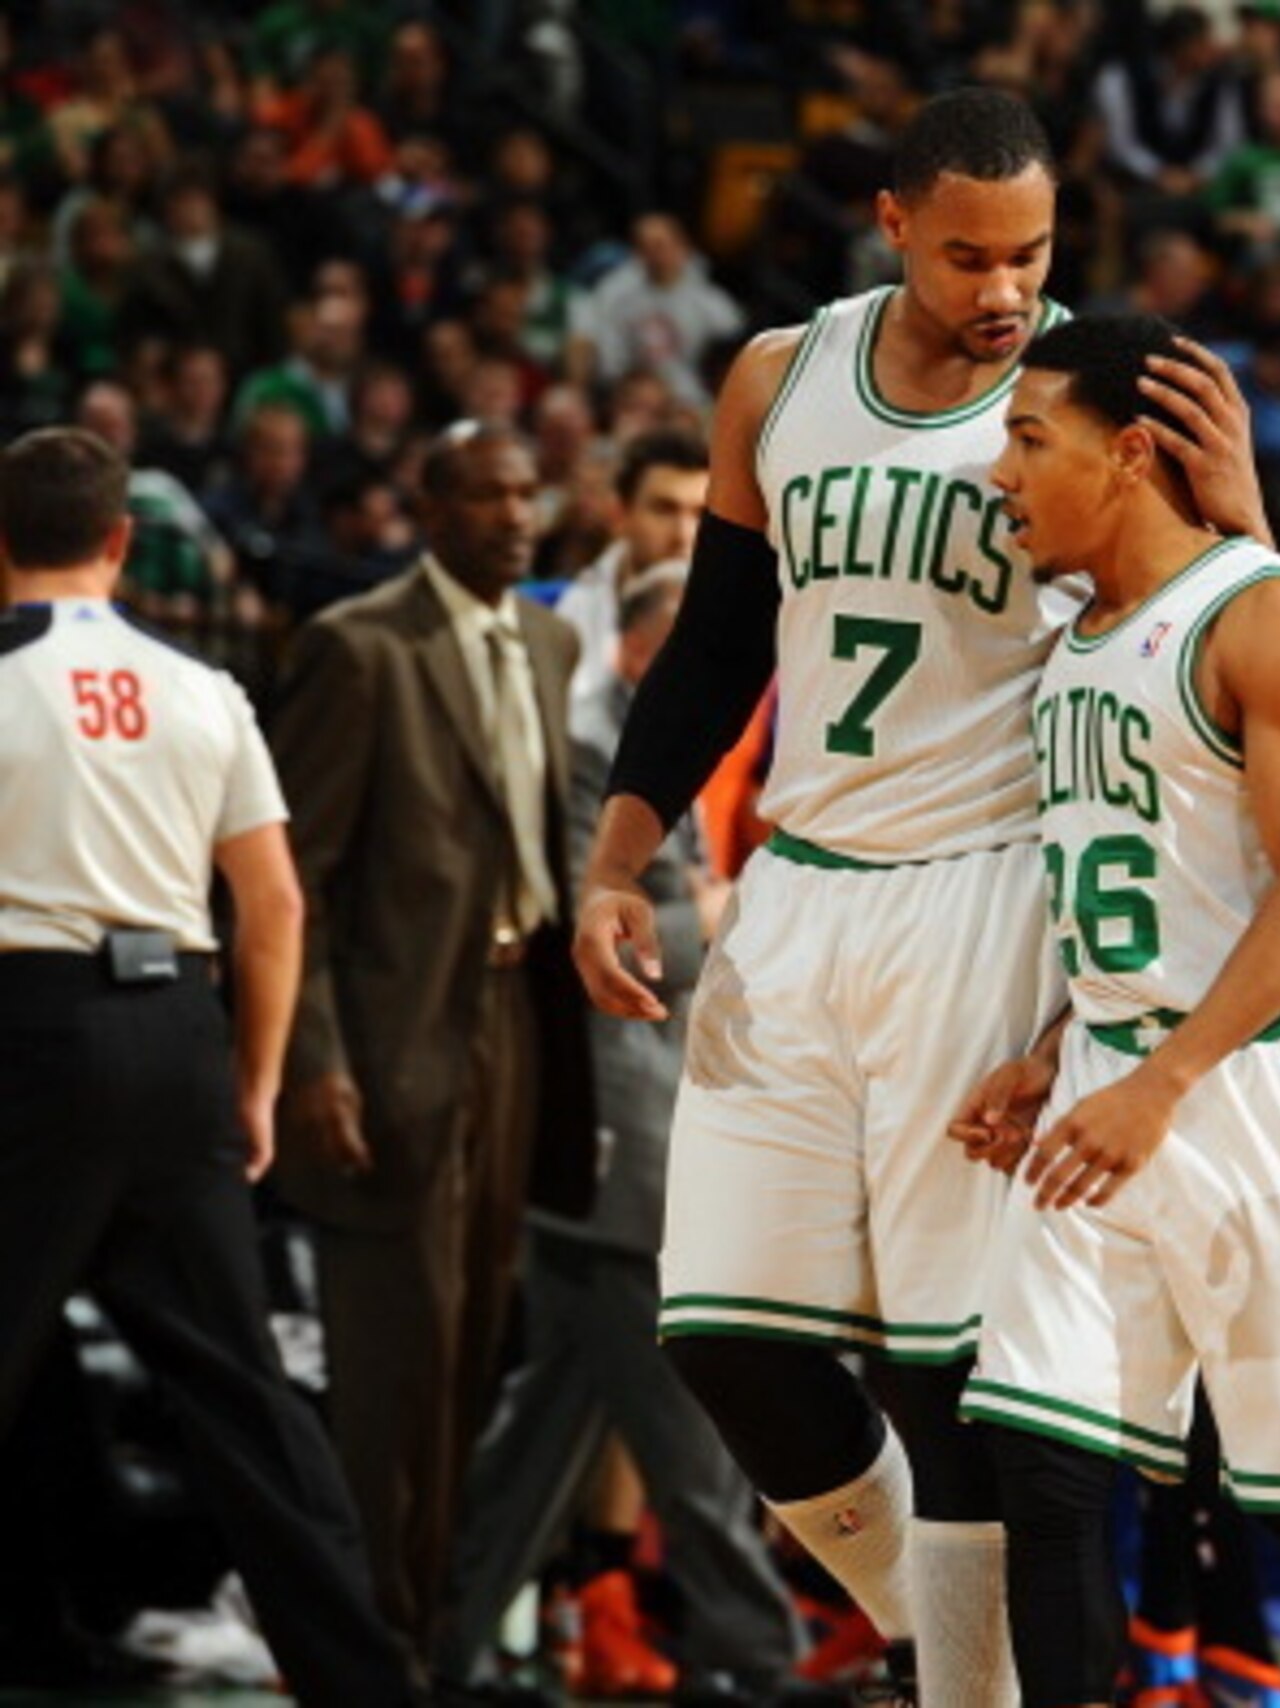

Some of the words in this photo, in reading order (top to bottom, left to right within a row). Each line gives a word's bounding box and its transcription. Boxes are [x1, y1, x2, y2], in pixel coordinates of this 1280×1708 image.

[781, 466, 1013, 615] CELTICS
[70, 668, 147, 741] 58
[825, 614, 922, 757] 7
[1031, 687, 1161, 824] ELTICS
